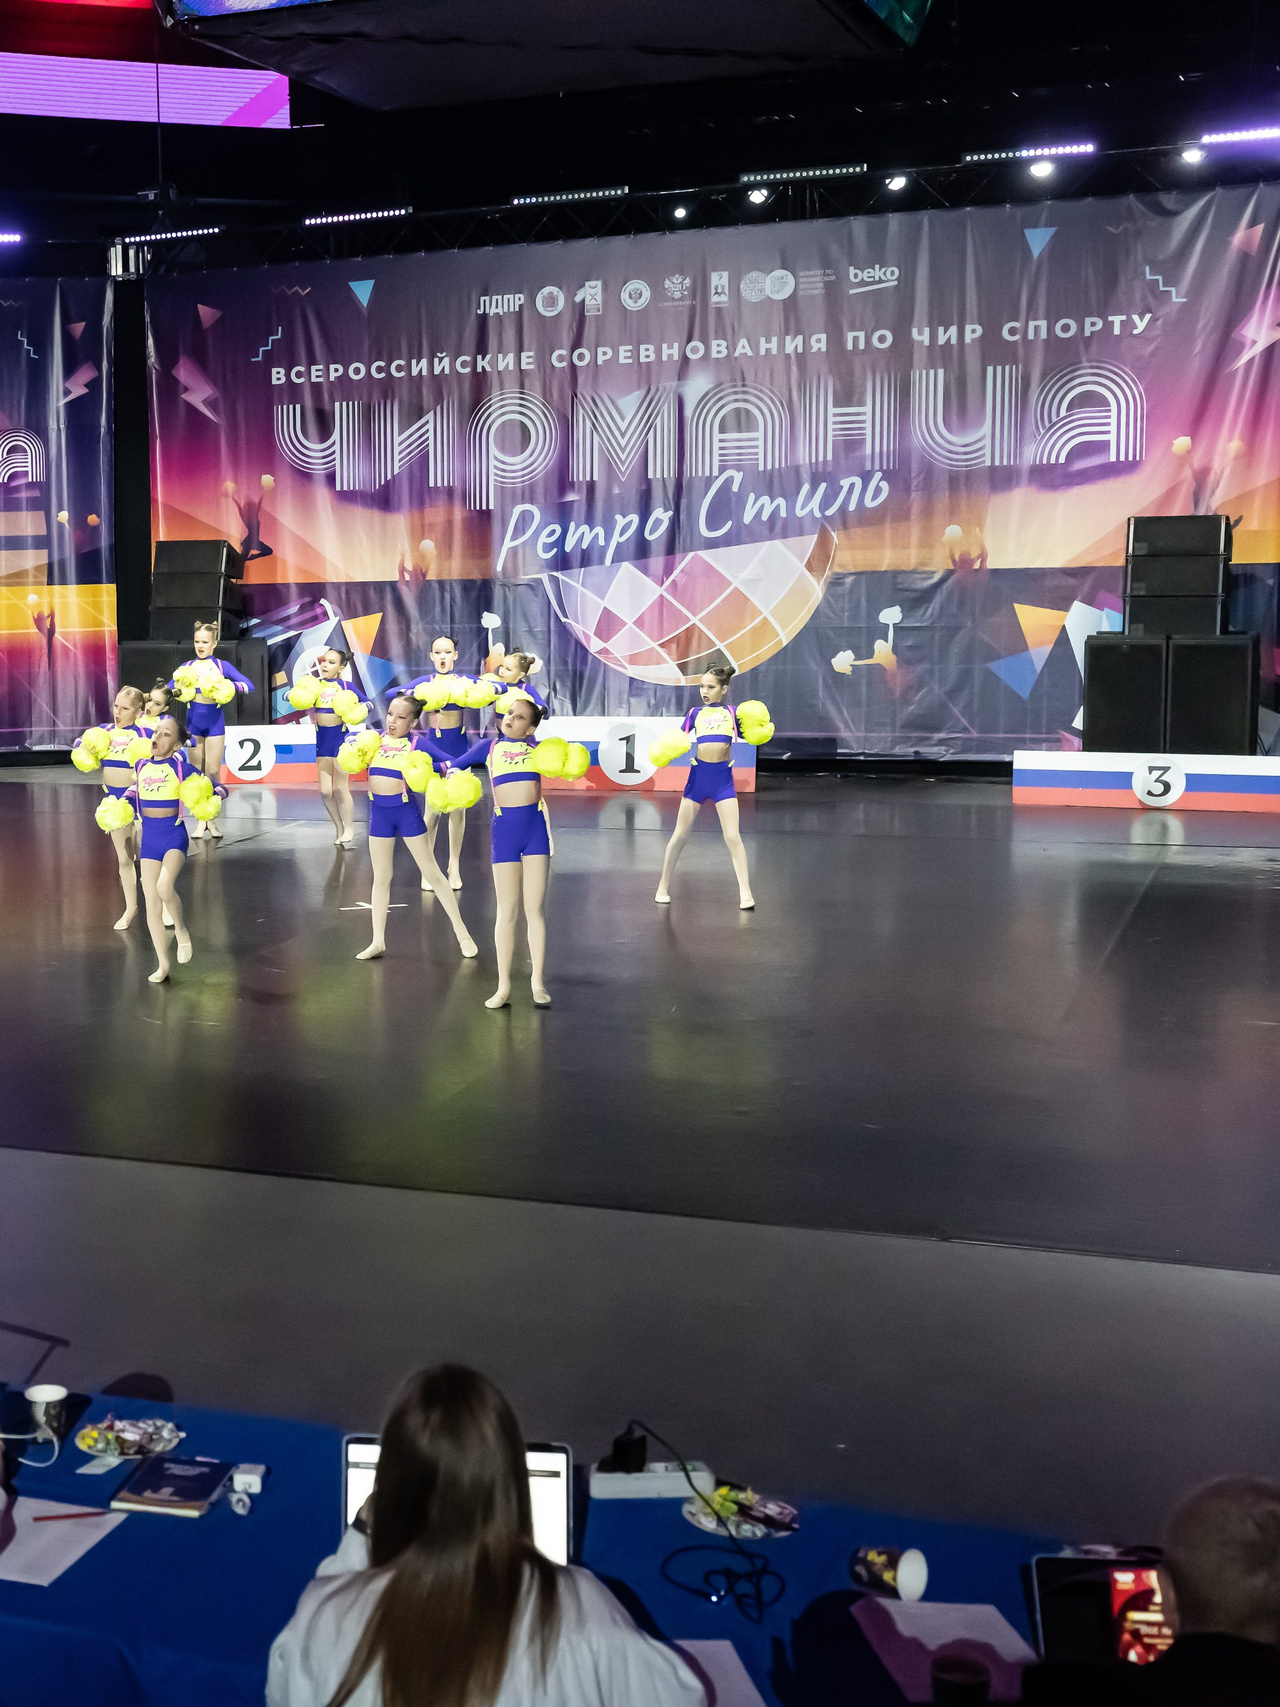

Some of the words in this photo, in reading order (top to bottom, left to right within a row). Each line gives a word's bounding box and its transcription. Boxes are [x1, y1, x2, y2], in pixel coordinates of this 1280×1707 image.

[849, 264, 900, 283] beko
[477, 293, 525, 316] ЛДПР
[271, 351, 536, 385] ВСЕРОССИЙСКИЕ
[550, 333, 828, 368] СОРЕВНОВАНИЯ
[847, 328, 894, 352] ПО
[912, 323, 983, 347] ЧИР
[1002, 313, 1154, 342] СПОРТУ
[496, 503, 674, 572] Ретро
[698, 469, 890, 538] Стиль
[238, 737, 263, 772] 2
[618, 733, 641, 774] 1
[1146, 765, 1172, 798] 3
